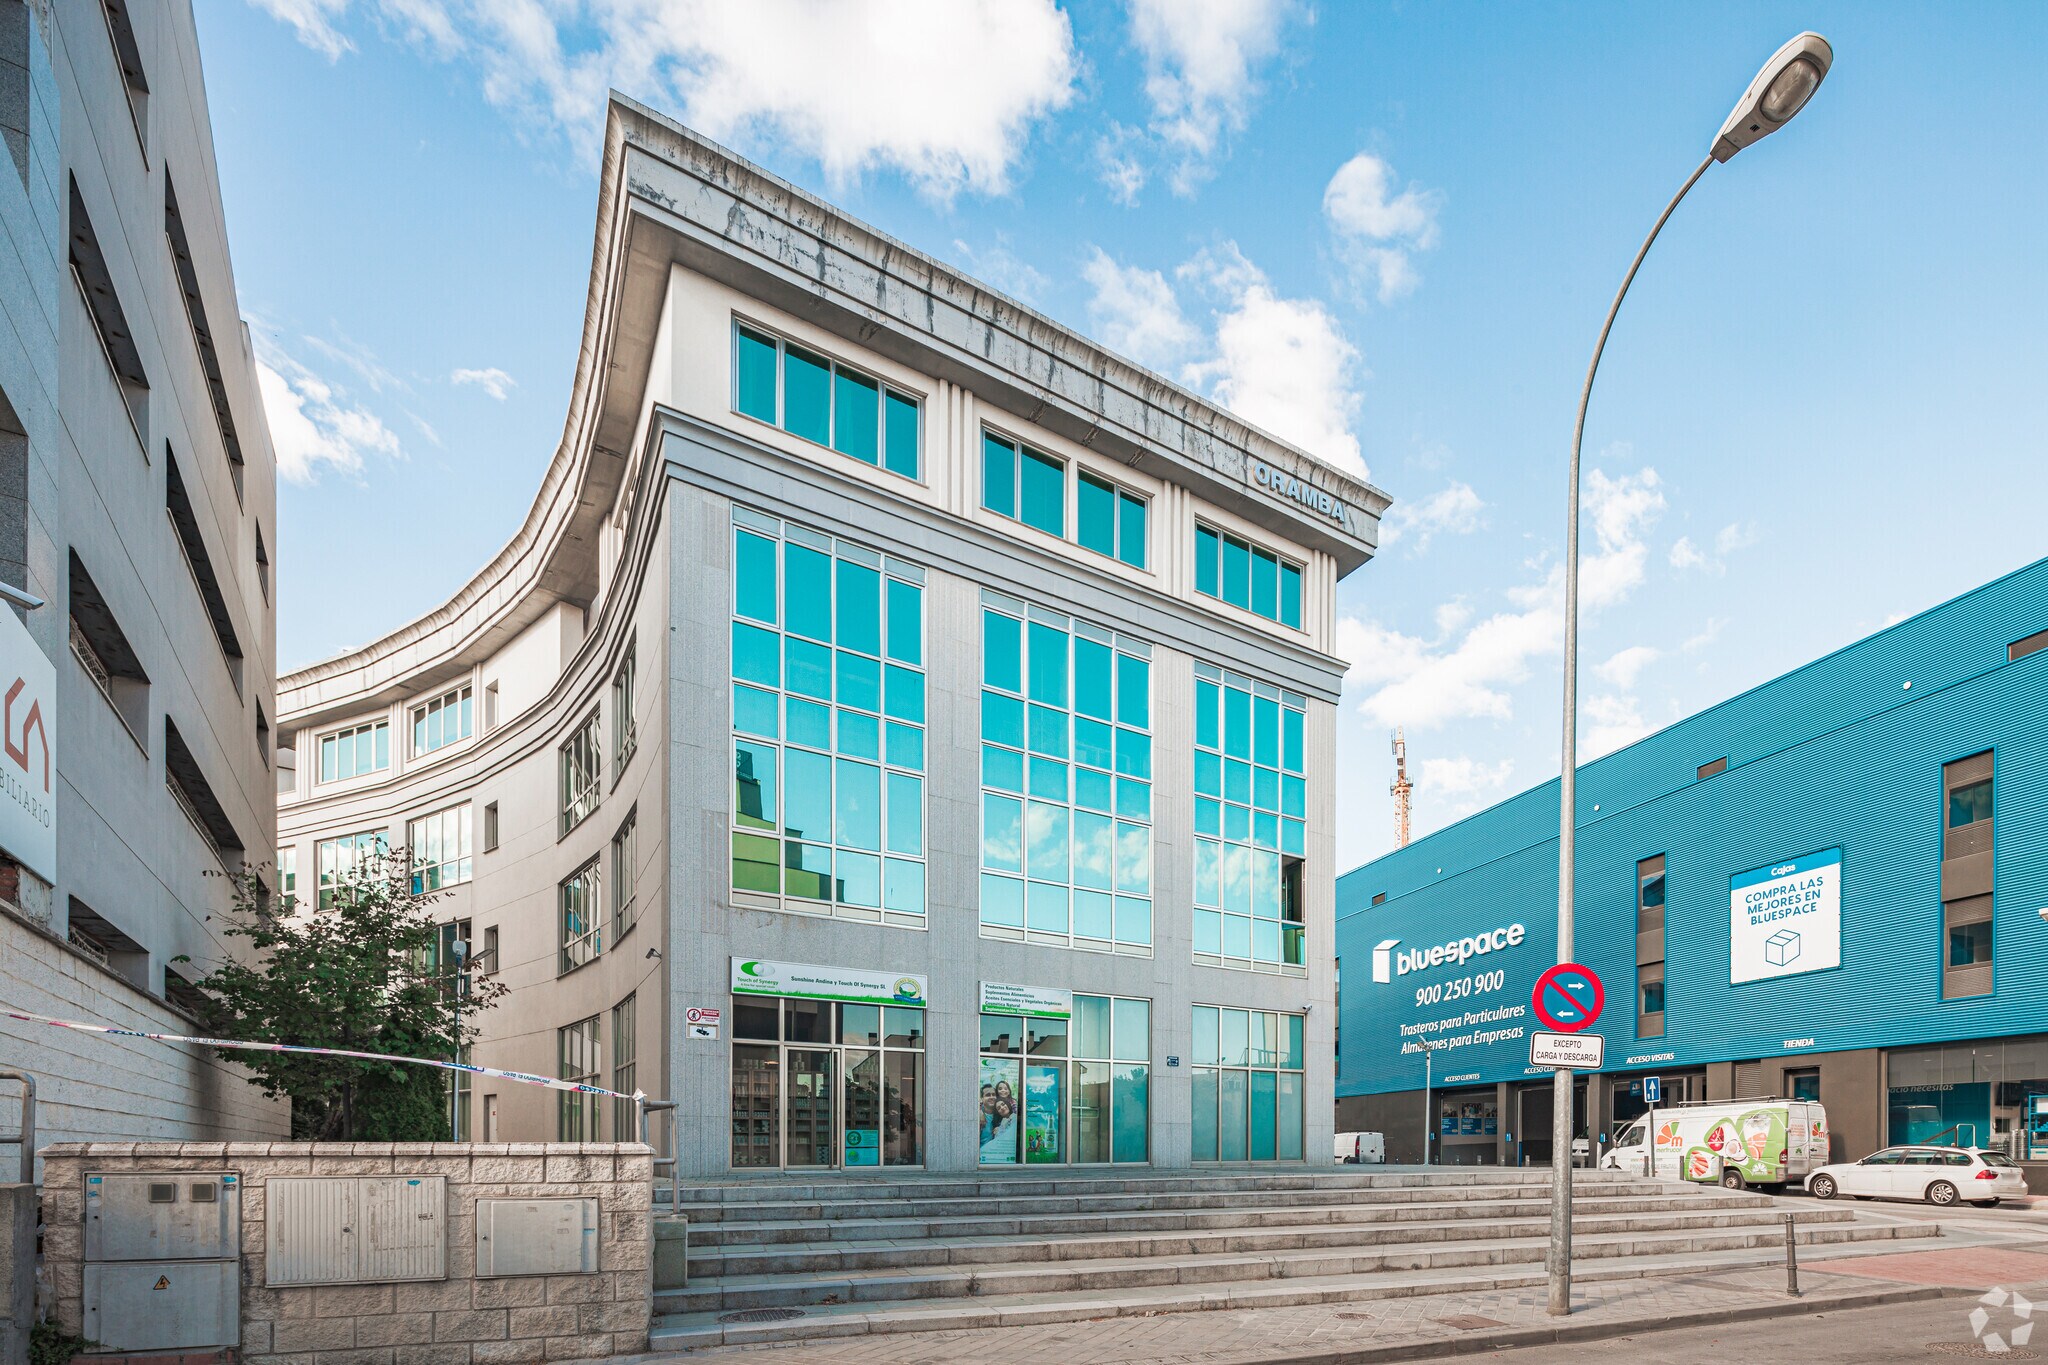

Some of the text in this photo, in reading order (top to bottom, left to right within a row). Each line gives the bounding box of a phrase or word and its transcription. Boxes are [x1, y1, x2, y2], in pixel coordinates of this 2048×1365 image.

[1253, 463, 1344, 524] ORAMBA
[1770, 864, 1796, 876] Cajas
[1745, 876, 1824, 904] COMPRA LAS
[1747, 889, 1821, 915] MEJORES EN
[1750, 902, 1817, 926] BLUESPACE
[1397, 923, 1525, 976] bluespace
[1415, 969, 1505, 1007] 900 250 900
[1400, 1005, 1526, 1037] Trasteros para Particulares
[1400, 1026, 1524, 1055] Almaenes para Empresas
[1553, 1039, 1582, 1049] EXCEPTO
[1783, 1037, 1815, 1048] TIENDA
[1536, 1050, 1598, 1062] CARGA Y DESCARGA
[1626, 1052, 1675, 1064] ACCESO VISITAS
[1444, 1073, 1480, 1083] ACCESO CLIENTES
[1524, 1066, 1544, 1075] ACCESO
